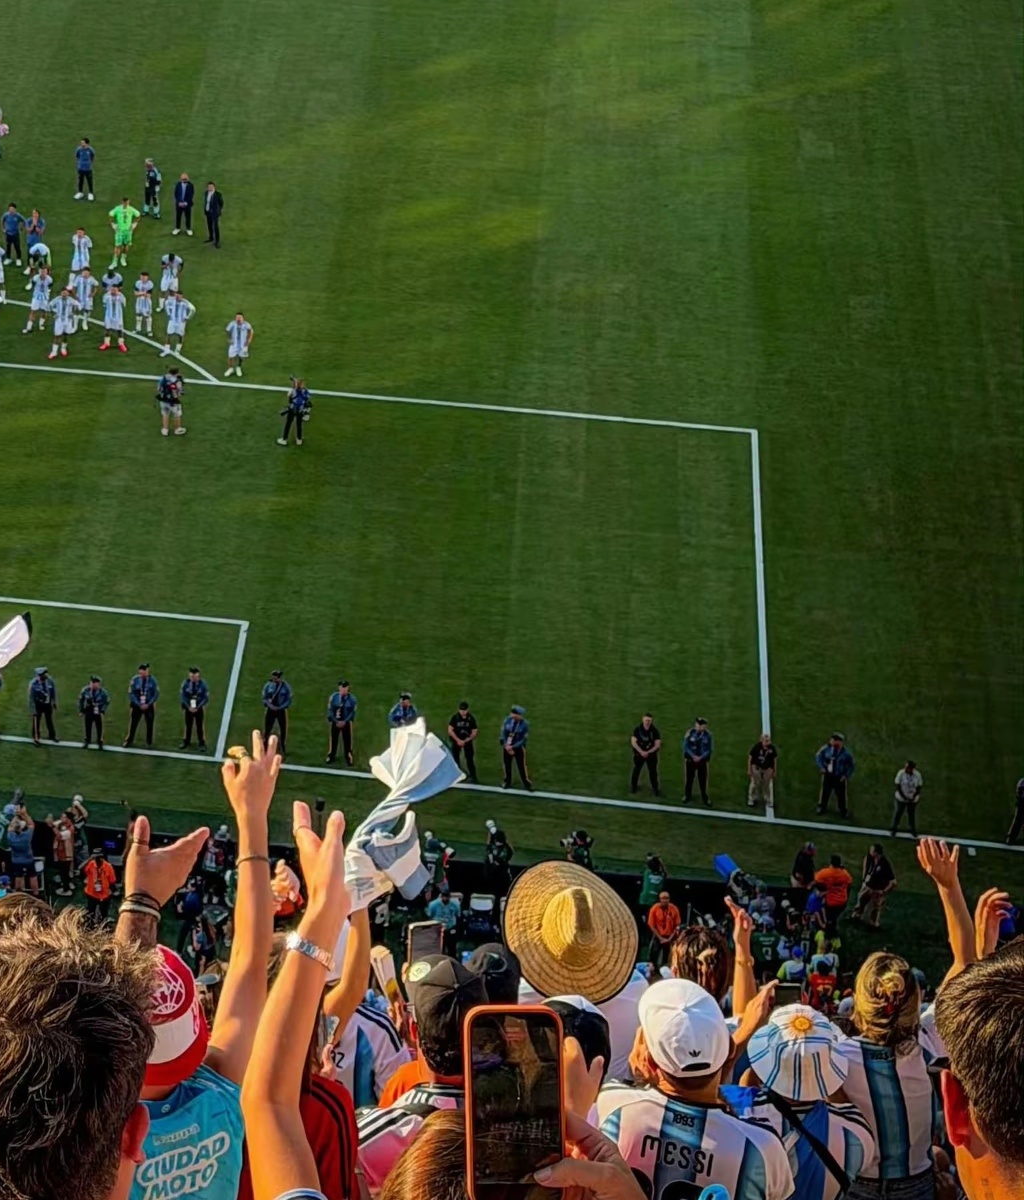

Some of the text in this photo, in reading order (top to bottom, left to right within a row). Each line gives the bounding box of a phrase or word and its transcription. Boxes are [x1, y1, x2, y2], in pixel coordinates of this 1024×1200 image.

[138, 1132, 229, 1185] CIUDAD
[640, 1134, 714, 1177] MESSI
[148, 1160, 217, 1200] MOTO
